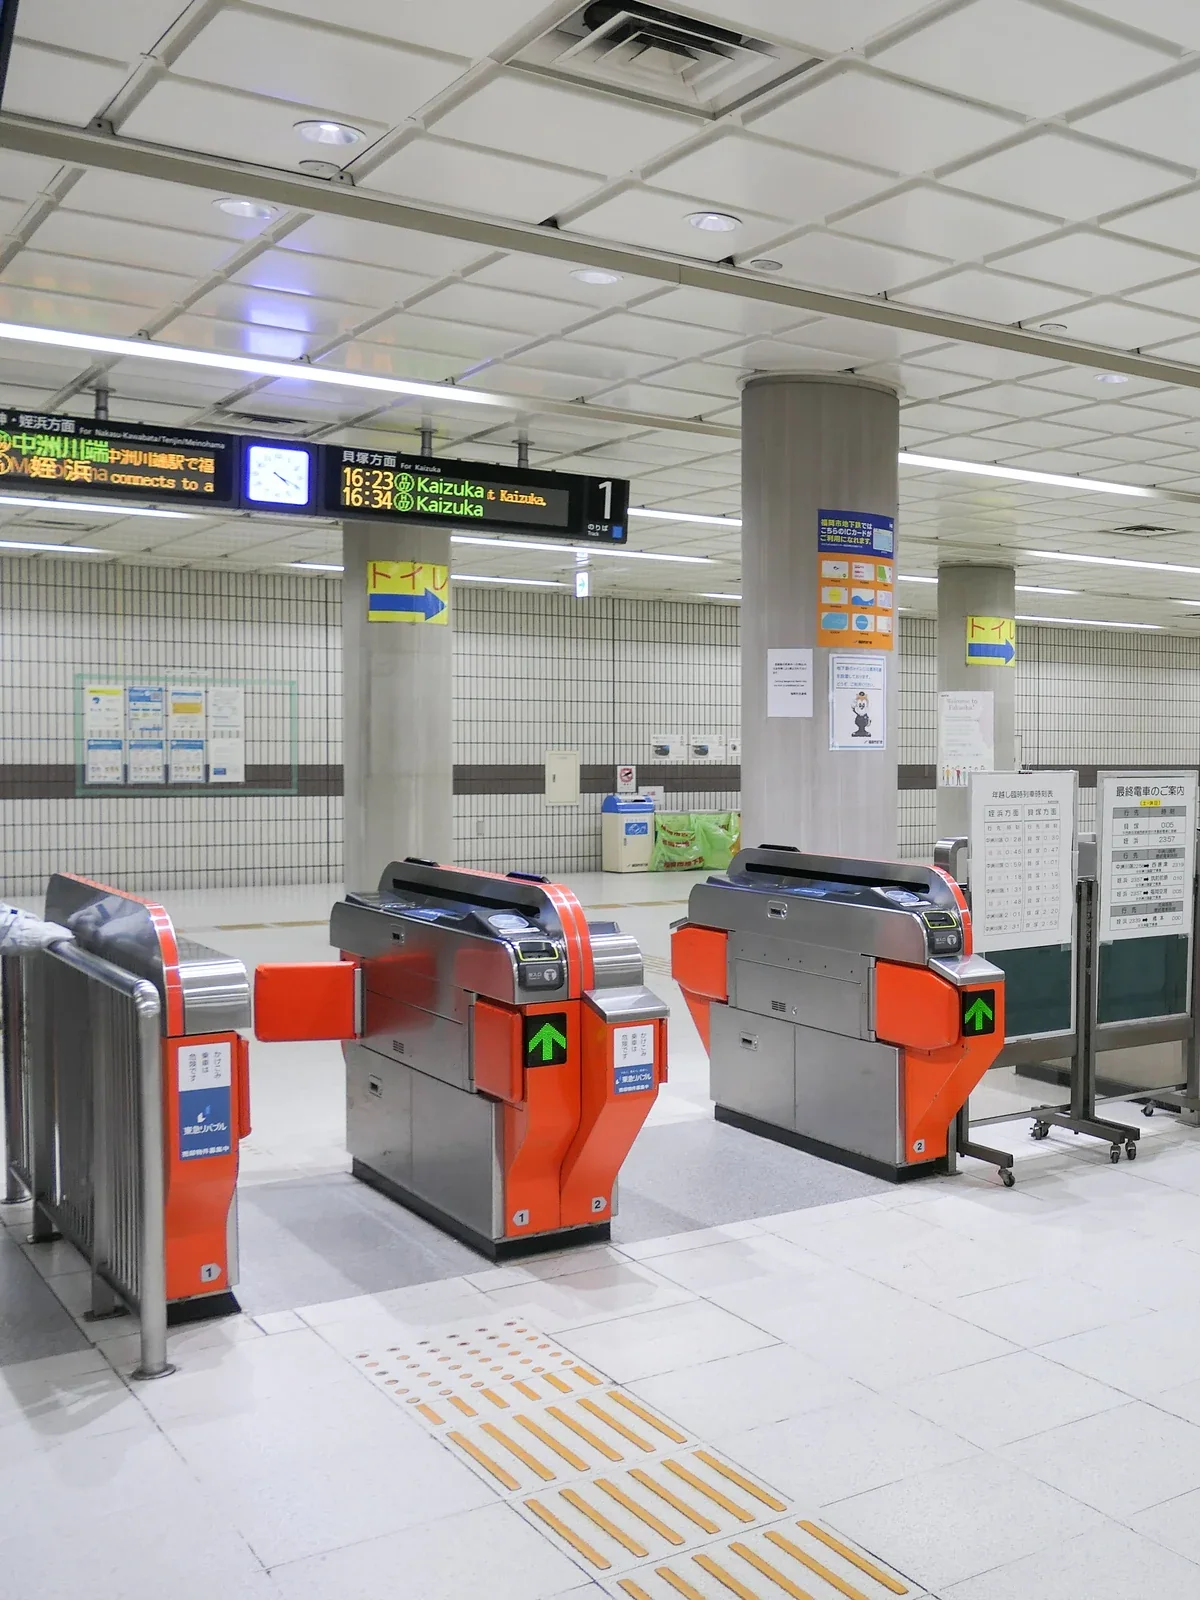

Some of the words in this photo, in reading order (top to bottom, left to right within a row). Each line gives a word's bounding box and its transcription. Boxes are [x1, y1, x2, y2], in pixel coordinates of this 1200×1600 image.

[79, 427, 92, 435] For
[12, 432, 109, 463] 中洲川端
[342, 450, 397, 468] 貝塚方面
[415, 464, 441, 473] Kaizuka
[110, 473, 176, 489] connects
[181, 478, 199, 491] to
[343, 467, 394, 490] 16:23
[417, 477, 484, 499] Kaizuka
[342, 486, 393, 509] 16:34
[598, 481, 613, 519] 1
[416, 495, 484, 517] Kaizuka
[587, 523, 608, 531] のりば
[821, 519, 873, 530] 福岡市地下鉄では
[372, 563, 448, 590] トイレ
[1116, 785, 1185, 797] 最終電車のご案内
[183, 1122, 228, 1135] 東急リバブル
[917, 1142, 923, 1150] 2
[594, 1199, 601, 1209] 2
[519, 1213, 524, 1222] 1
[206, 1266, 213, 1279] 1
